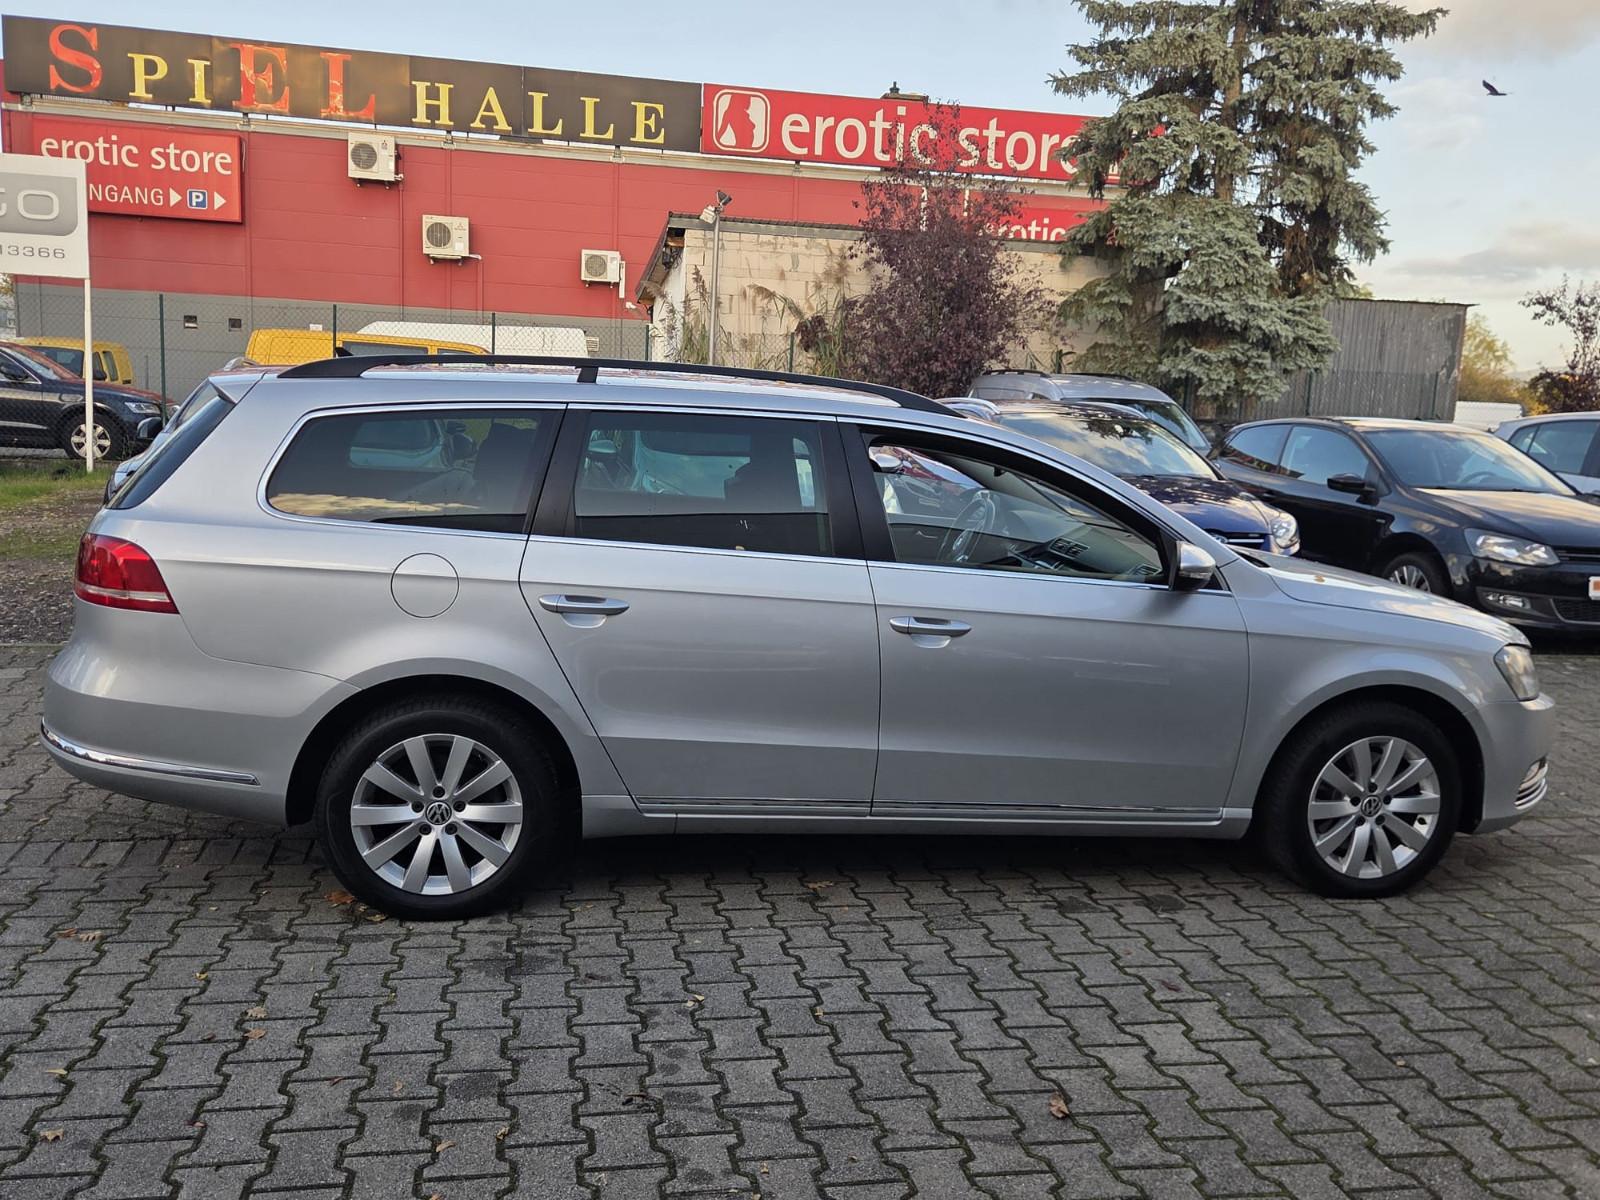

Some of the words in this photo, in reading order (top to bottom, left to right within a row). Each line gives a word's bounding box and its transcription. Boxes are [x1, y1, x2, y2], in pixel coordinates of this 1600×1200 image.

[41, 135, 139, 168] erotic
[151, 143, 232, 175] store
[781, 106, 937, 165] erotic
[89, 184, 164, 206] NGANG
